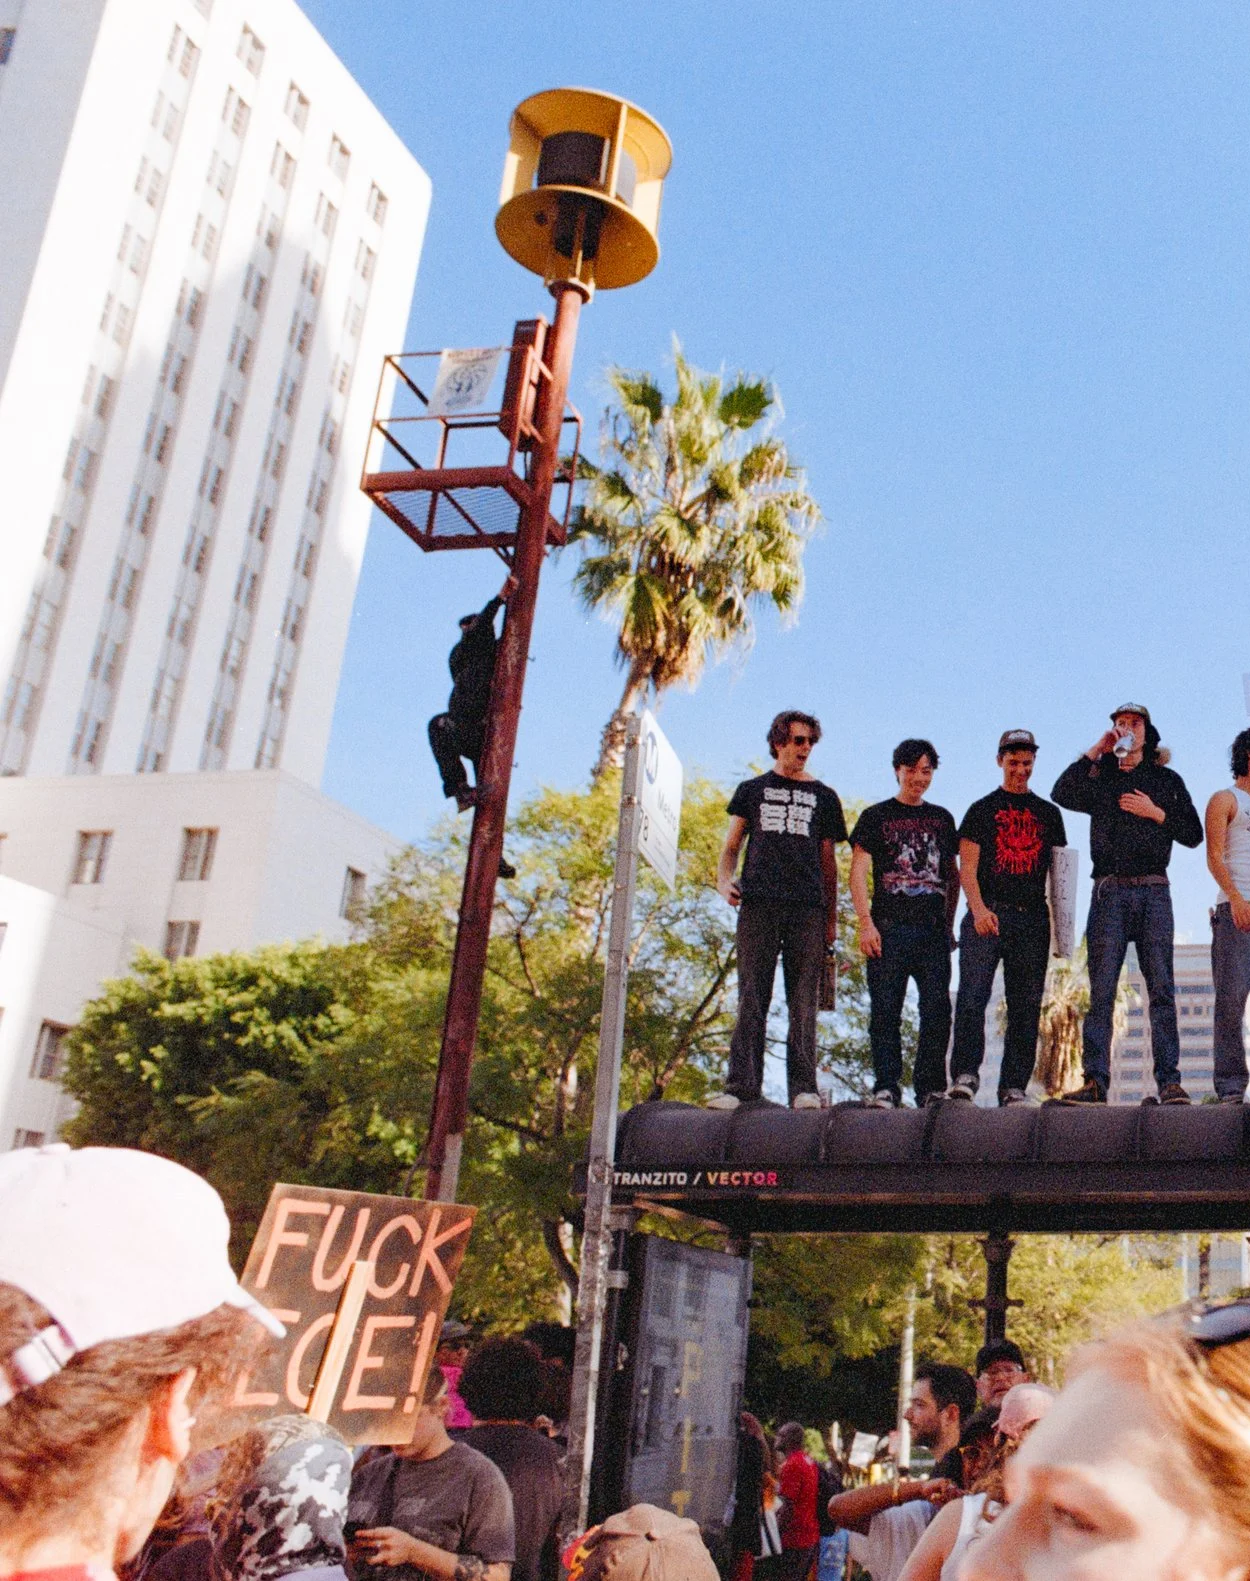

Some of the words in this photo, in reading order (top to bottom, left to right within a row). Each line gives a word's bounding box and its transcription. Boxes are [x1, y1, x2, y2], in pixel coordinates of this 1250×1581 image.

[613, 1171, 687, 1185] TRANZITO
[707, 1171, 778, 1185] VECTOR
[255, 1198, 472, 1299] FUCK
